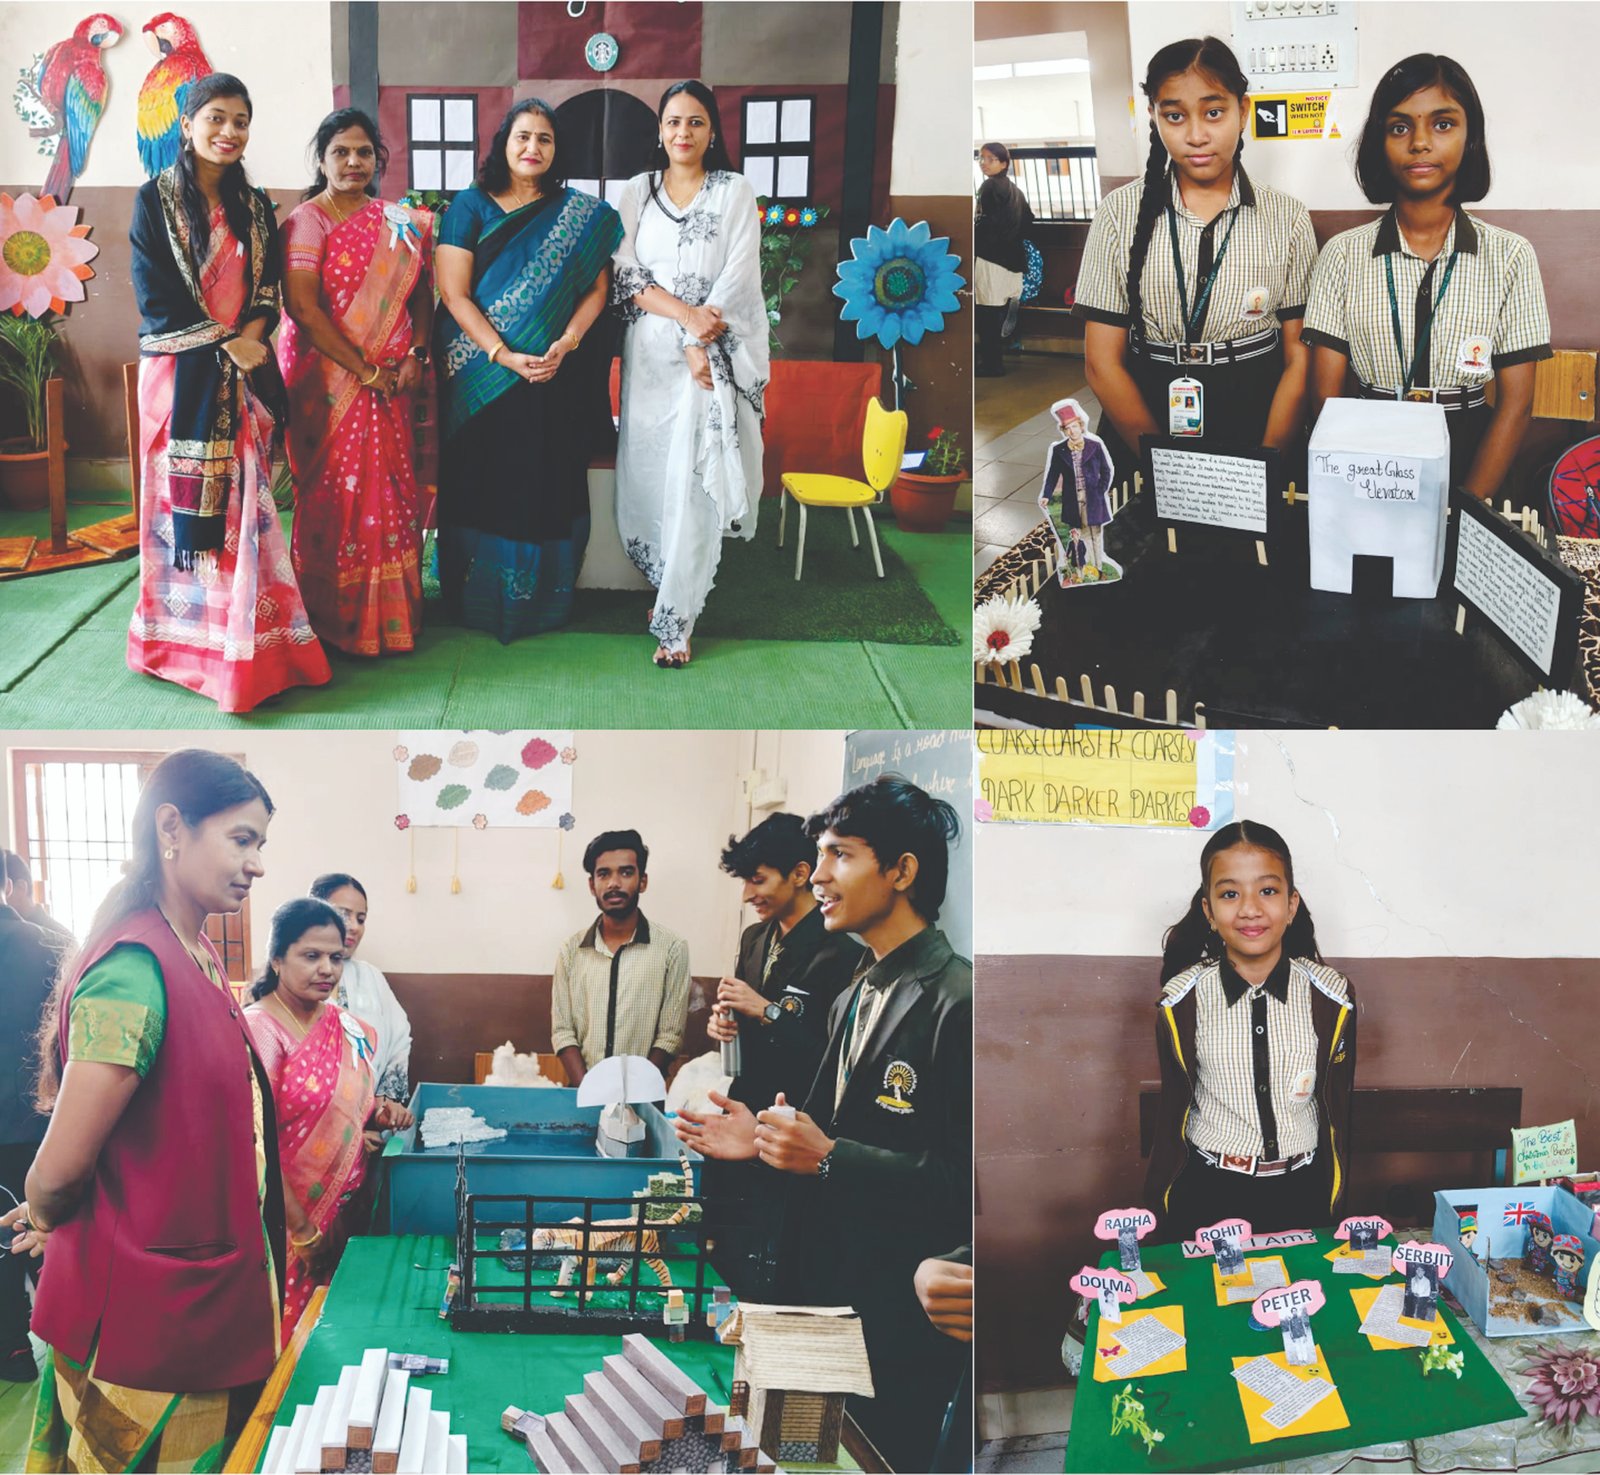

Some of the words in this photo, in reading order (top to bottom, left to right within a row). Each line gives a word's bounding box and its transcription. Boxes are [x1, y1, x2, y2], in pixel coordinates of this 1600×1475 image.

[1290, 102, 1325, 112] SWITCH
[1315, 454, 1340, 474] The
[1346, 459, 1383, 482] great
[1384, 460, 1415, 479] Glass
[1360, 479, 1416, 500] Elevator
[981, 778, 1035, 813] DARK
[1043, 782, 1121, 818] DARKER
[1520, 1135, 1536, 1148] The
[1537, 1128, 1562, 1144] Best
[1104, 1214, 1152, 1230] RADHA
[1344, 1221, 1384, 1232] NASIR
[1200, 1224, 1244, 1242] ROHIT
[1396, 1247, 1454, 1267] SERBJIT
[1080, 1275, 1133, 1294] DOLMA
[1261, 1288, 1312, 1313] PETER
